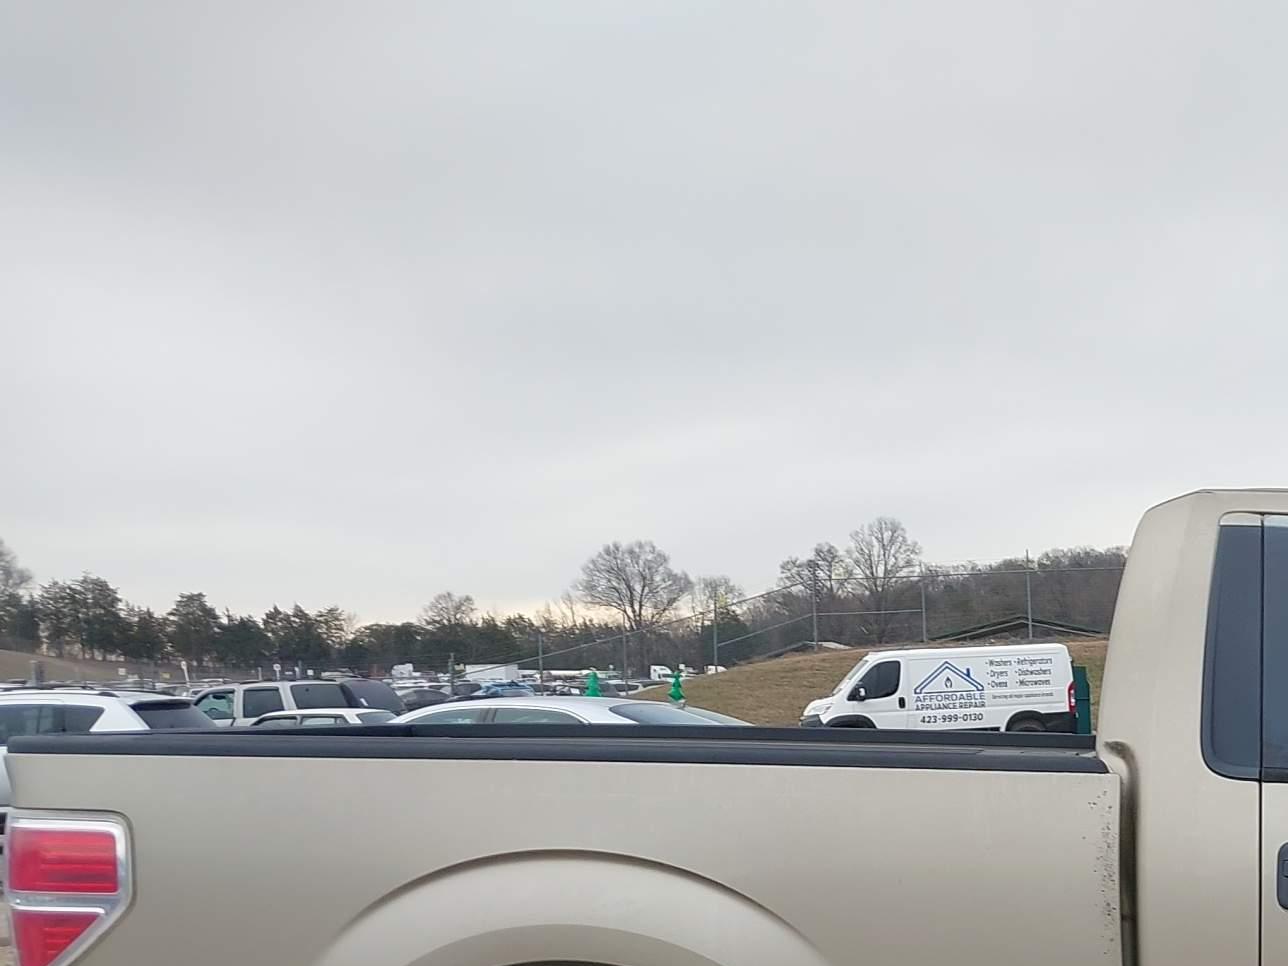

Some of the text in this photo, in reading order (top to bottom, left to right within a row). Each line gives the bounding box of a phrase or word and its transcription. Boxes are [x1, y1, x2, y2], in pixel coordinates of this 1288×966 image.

[990, 669, 1009, 679] Dryers
[914, 693, 986, 703] AFFORDABLE
[915, 700, 986, 711] APPLIANCE REPAIR
[920, 712, 984, 724] 423-999-0130
